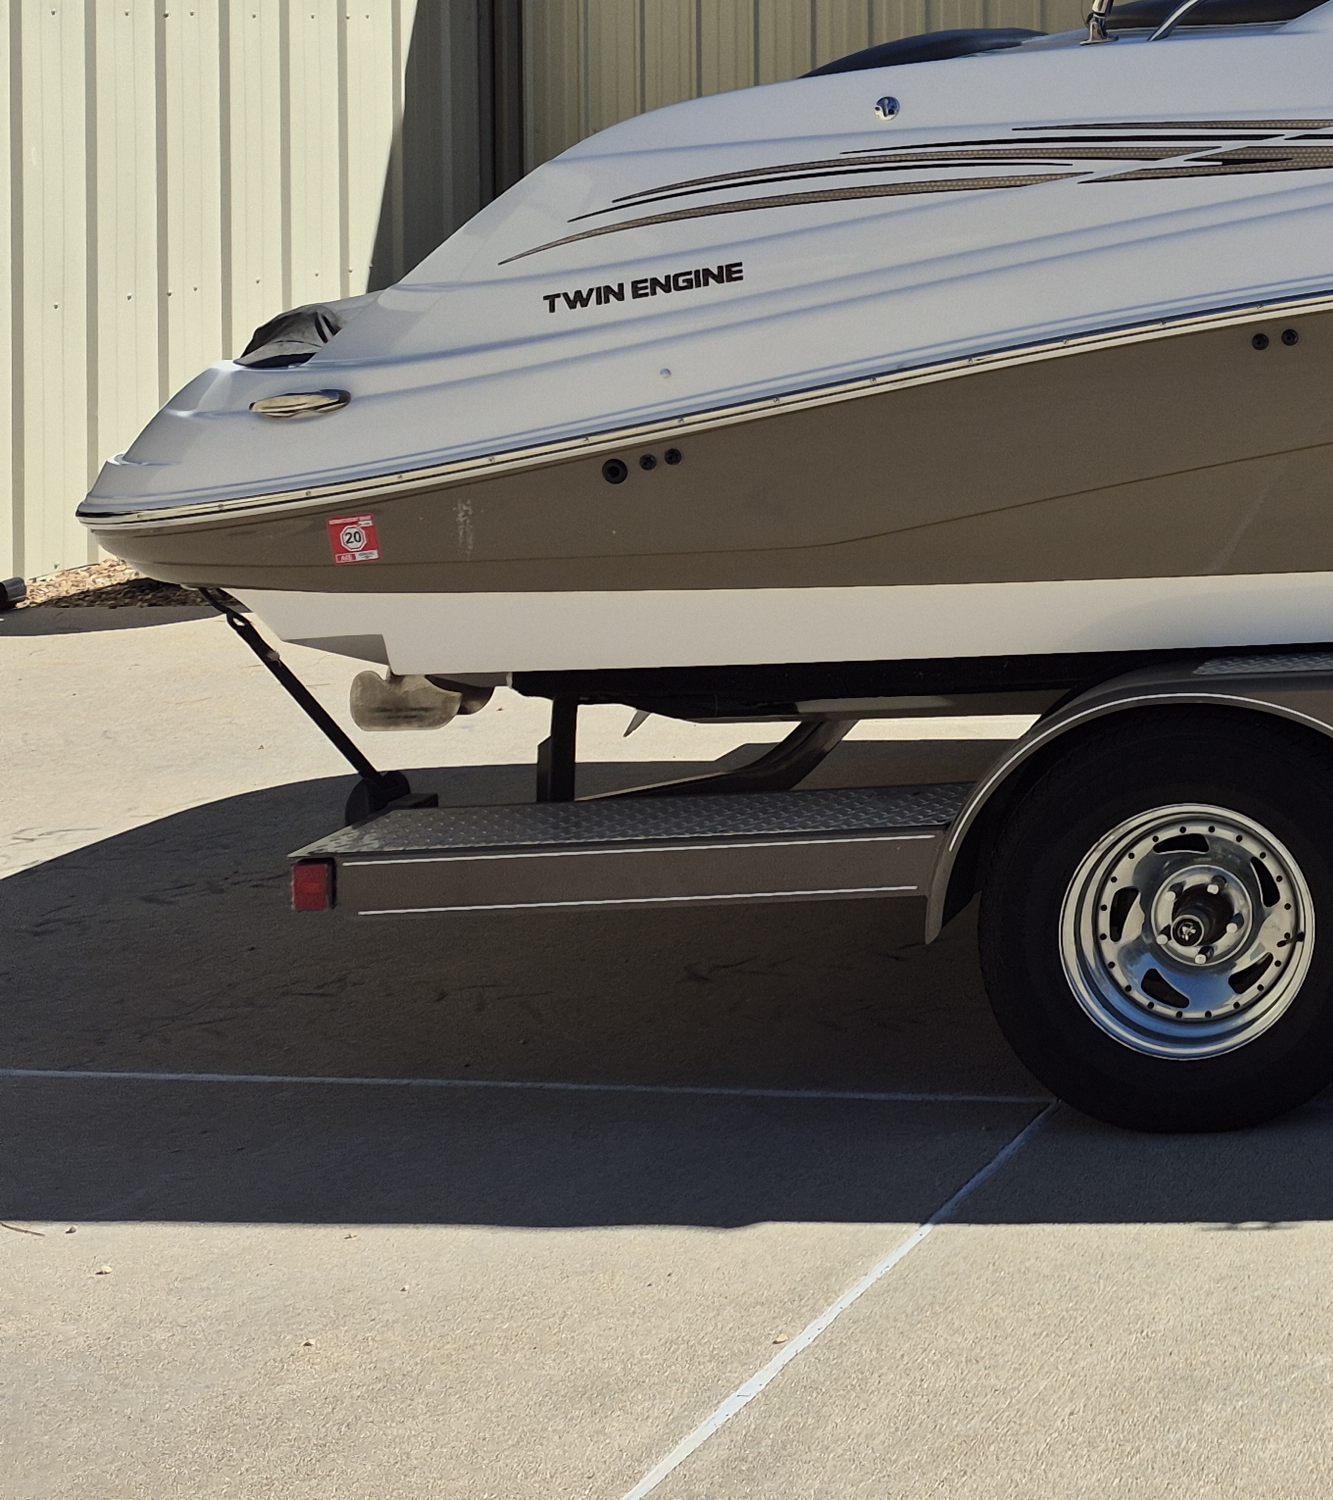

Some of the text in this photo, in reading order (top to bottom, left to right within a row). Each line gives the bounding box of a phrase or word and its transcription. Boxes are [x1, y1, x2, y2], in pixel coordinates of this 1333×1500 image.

[543, 262, 744, 313] TWIN ENGINE
[345, 531, 362, 544] 20
